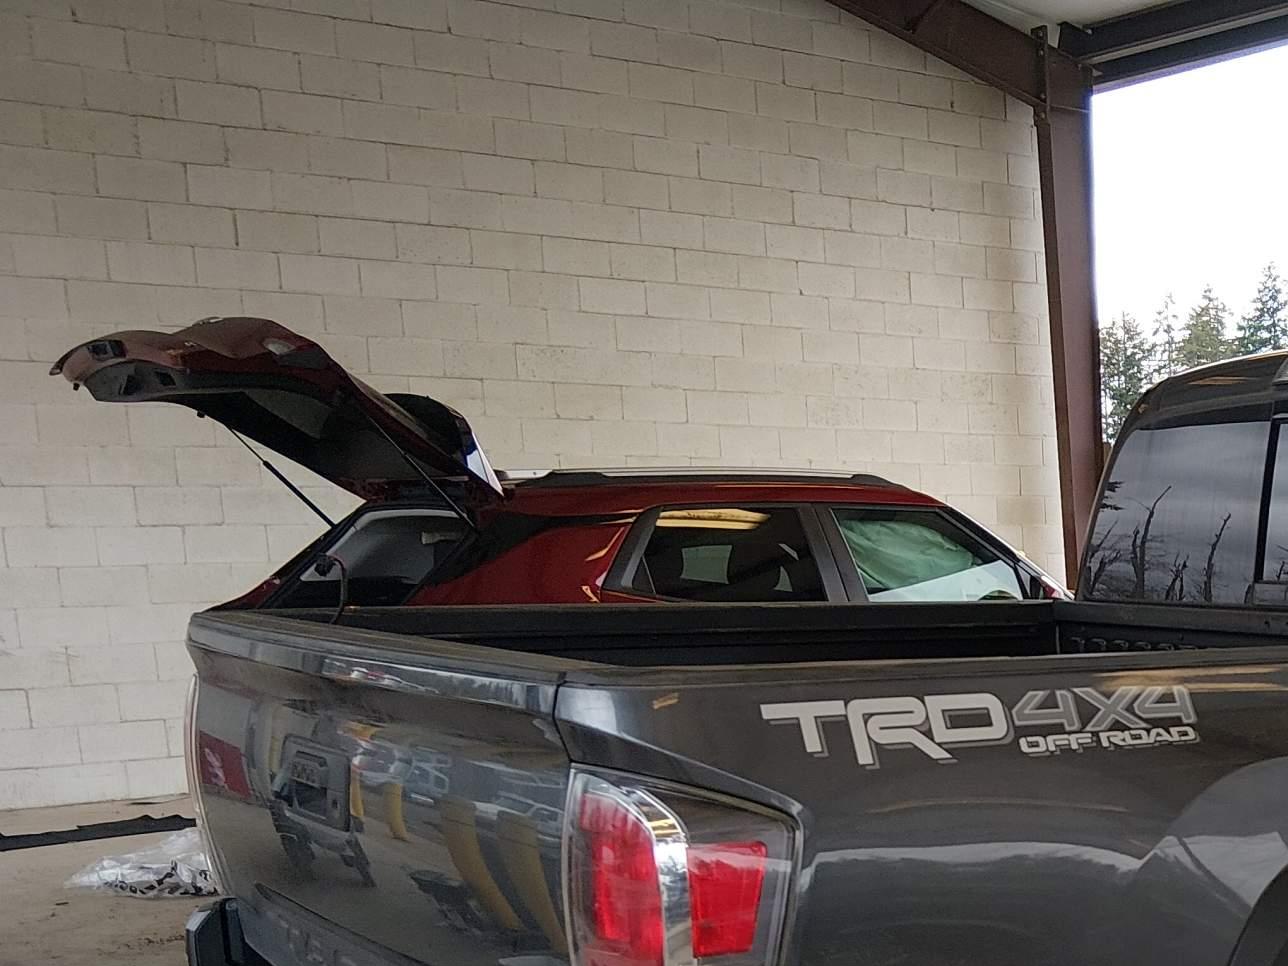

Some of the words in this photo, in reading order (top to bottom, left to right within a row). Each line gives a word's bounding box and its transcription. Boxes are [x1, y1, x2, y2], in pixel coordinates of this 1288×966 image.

[760, 692, 1012, 768] TRD
[1018, 732, 1096, 756] OFF
[1100, 726, 1199, 751] ROAD
